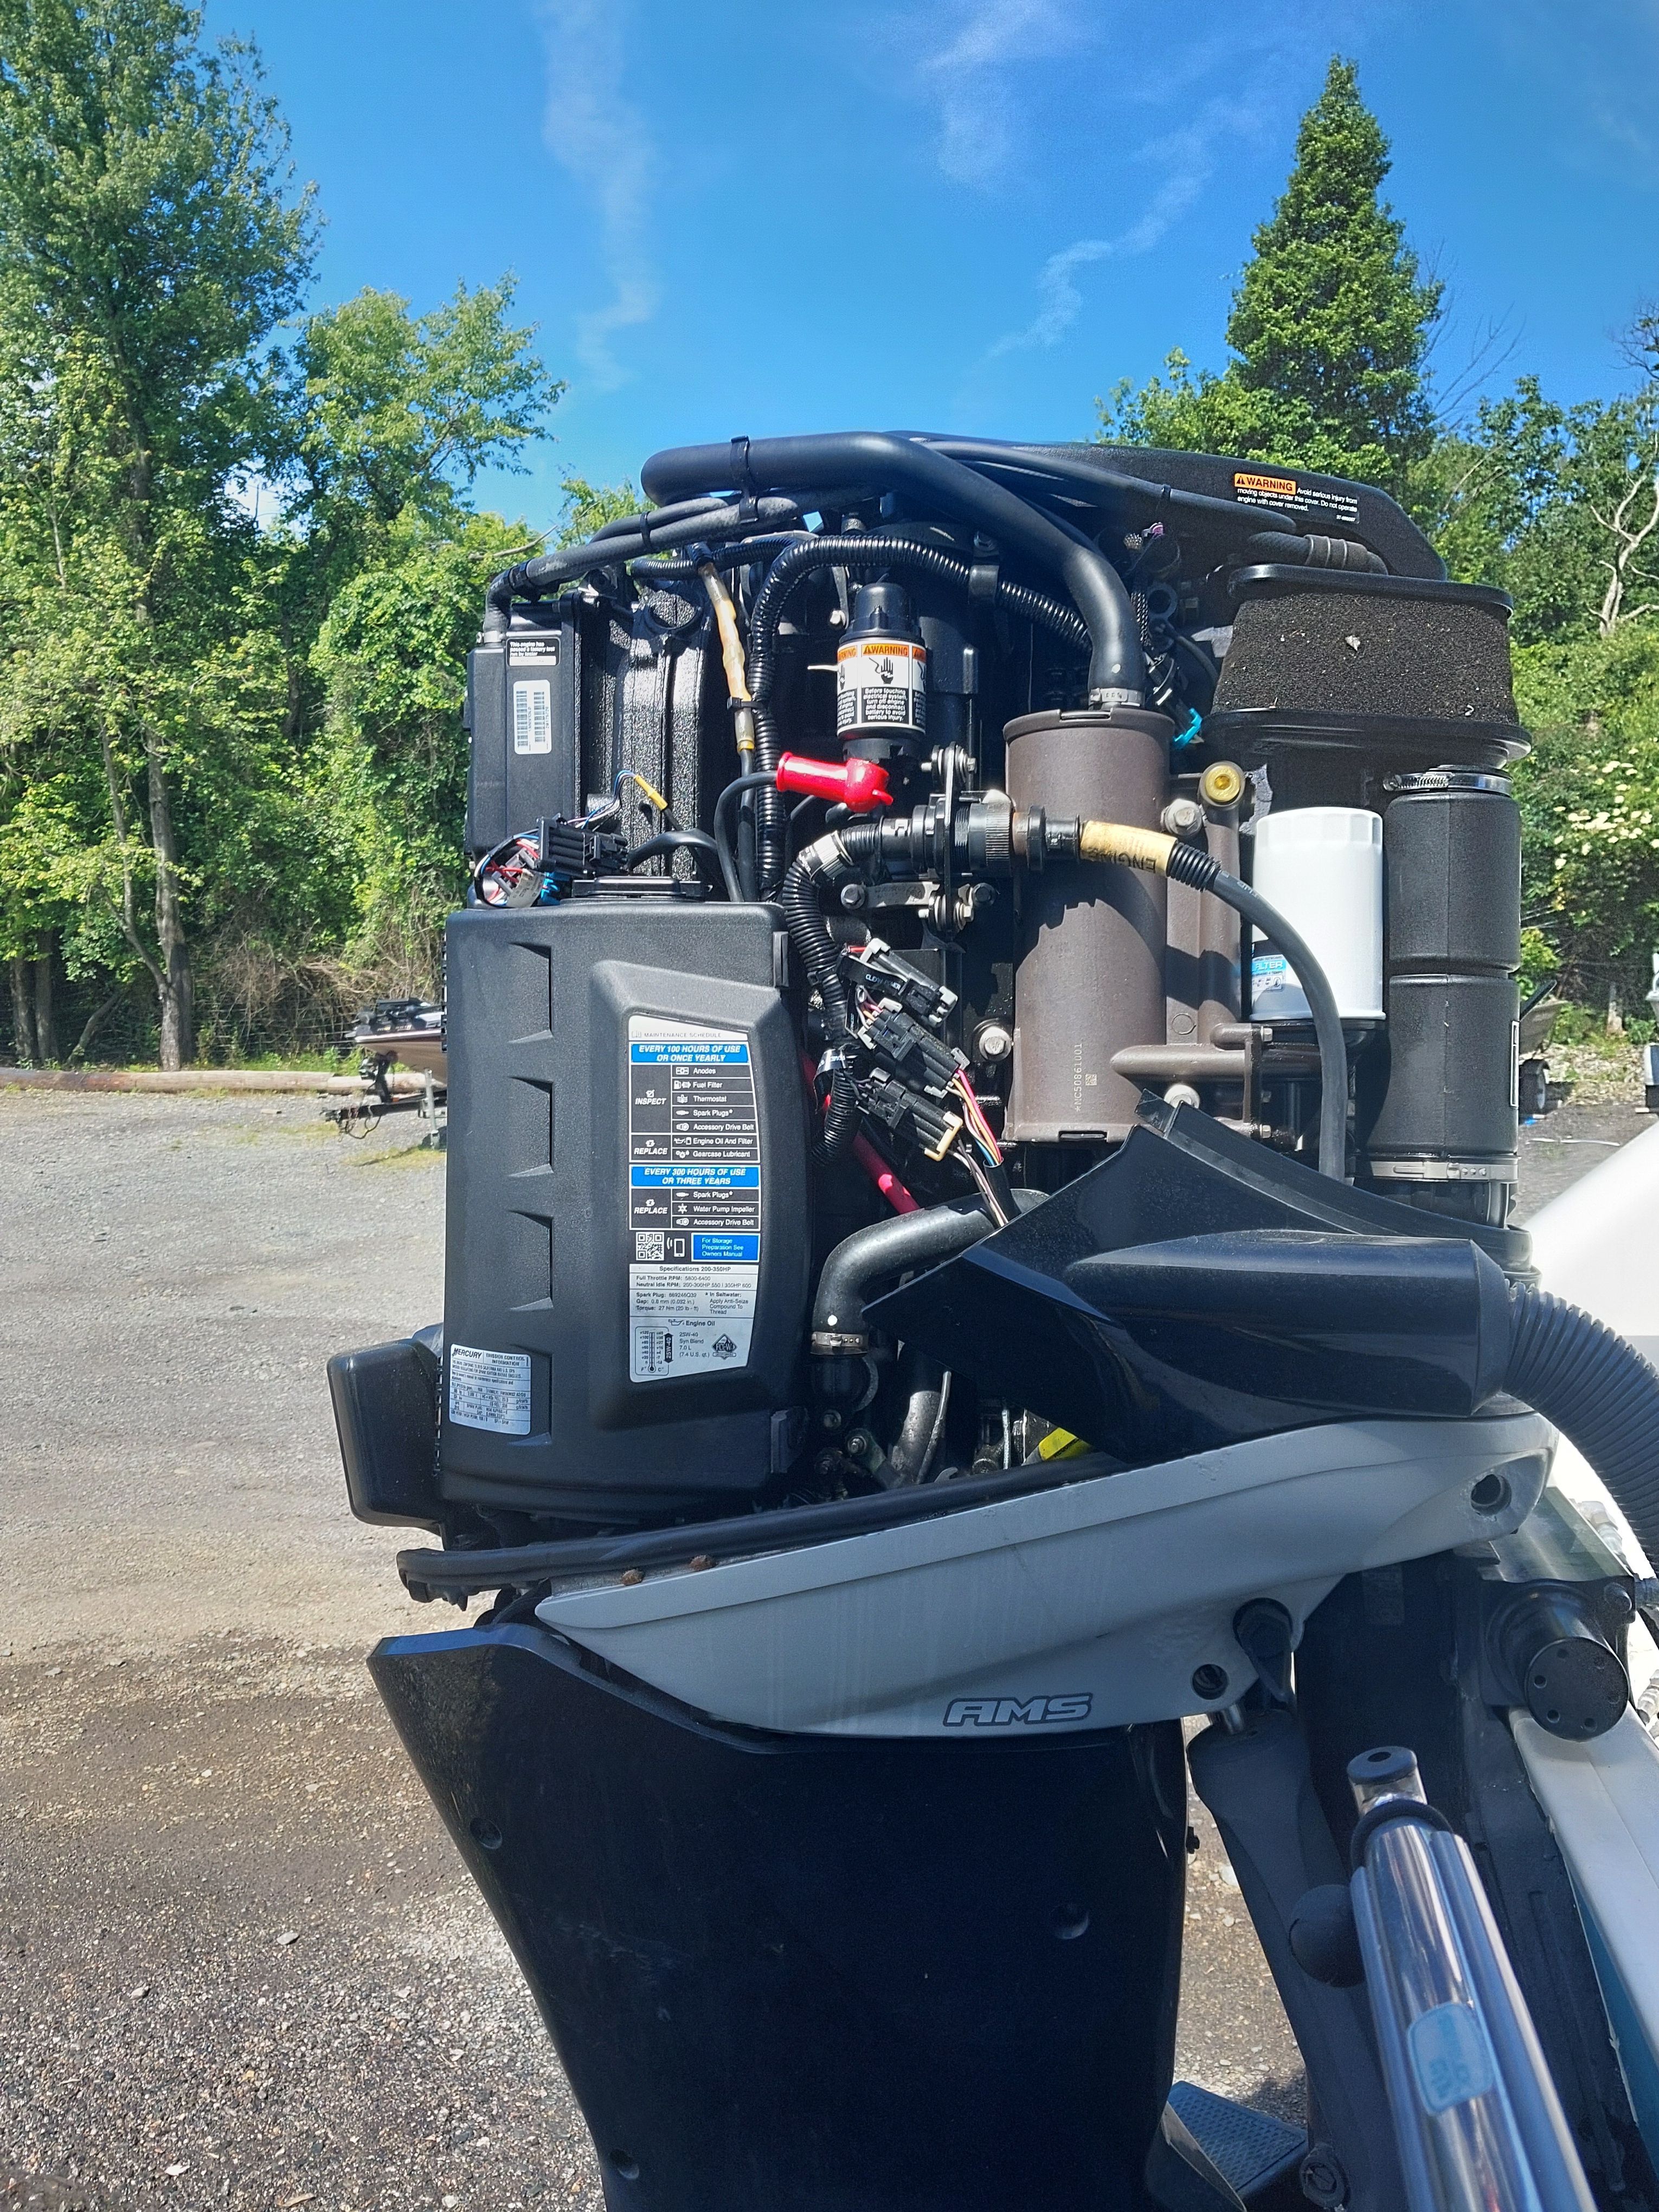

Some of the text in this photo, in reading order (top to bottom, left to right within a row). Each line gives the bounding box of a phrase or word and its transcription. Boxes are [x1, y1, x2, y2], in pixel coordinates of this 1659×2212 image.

[1247, 477, 1293, 491] WARNING
[1237, 488, 1258, 497] moving
[1258, 490, 1278, 498] objects
[1338, 503, 1358, 512] operate
[1297, 487, 1358, 505] Avoid serious injury from
[1284, 503, 1309, 511] removed.
[872, 645, 908, 655] WARNING
[670, 1054, 693, 1062] ONCE
[693, 1123, 724, 1131] Accessory
[693, 1137, 713, 1146] Engine
[452, 1348, 482, 1359] MERCURY
[943, 1692, 1094, 1727] AMS
